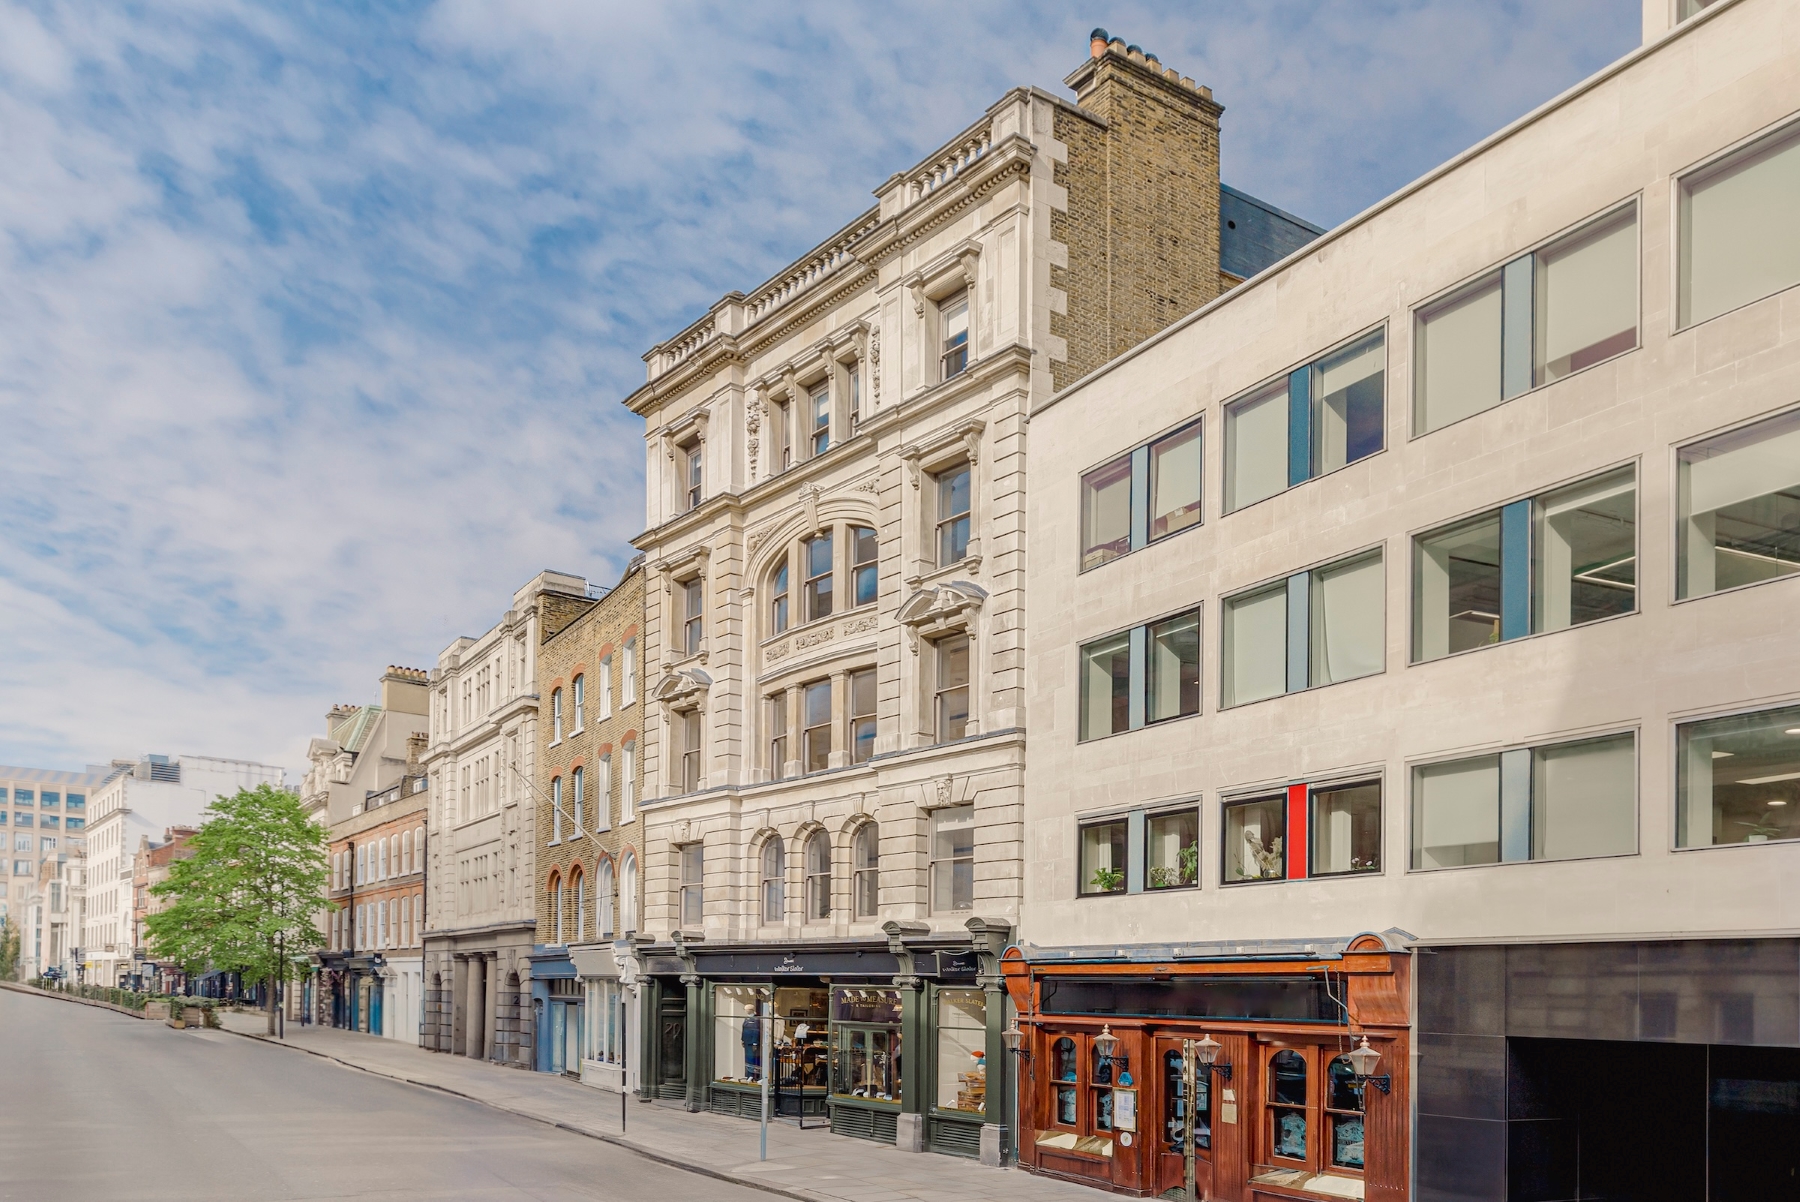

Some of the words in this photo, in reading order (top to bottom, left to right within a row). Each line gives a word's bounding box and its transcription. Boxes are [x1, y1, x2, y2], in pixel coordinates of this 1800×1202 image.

[841, 996, 860, 1004] MADE
[867, 995, 897, 1004] MEASURE
[965, 999, 985, 1007] SLATER
